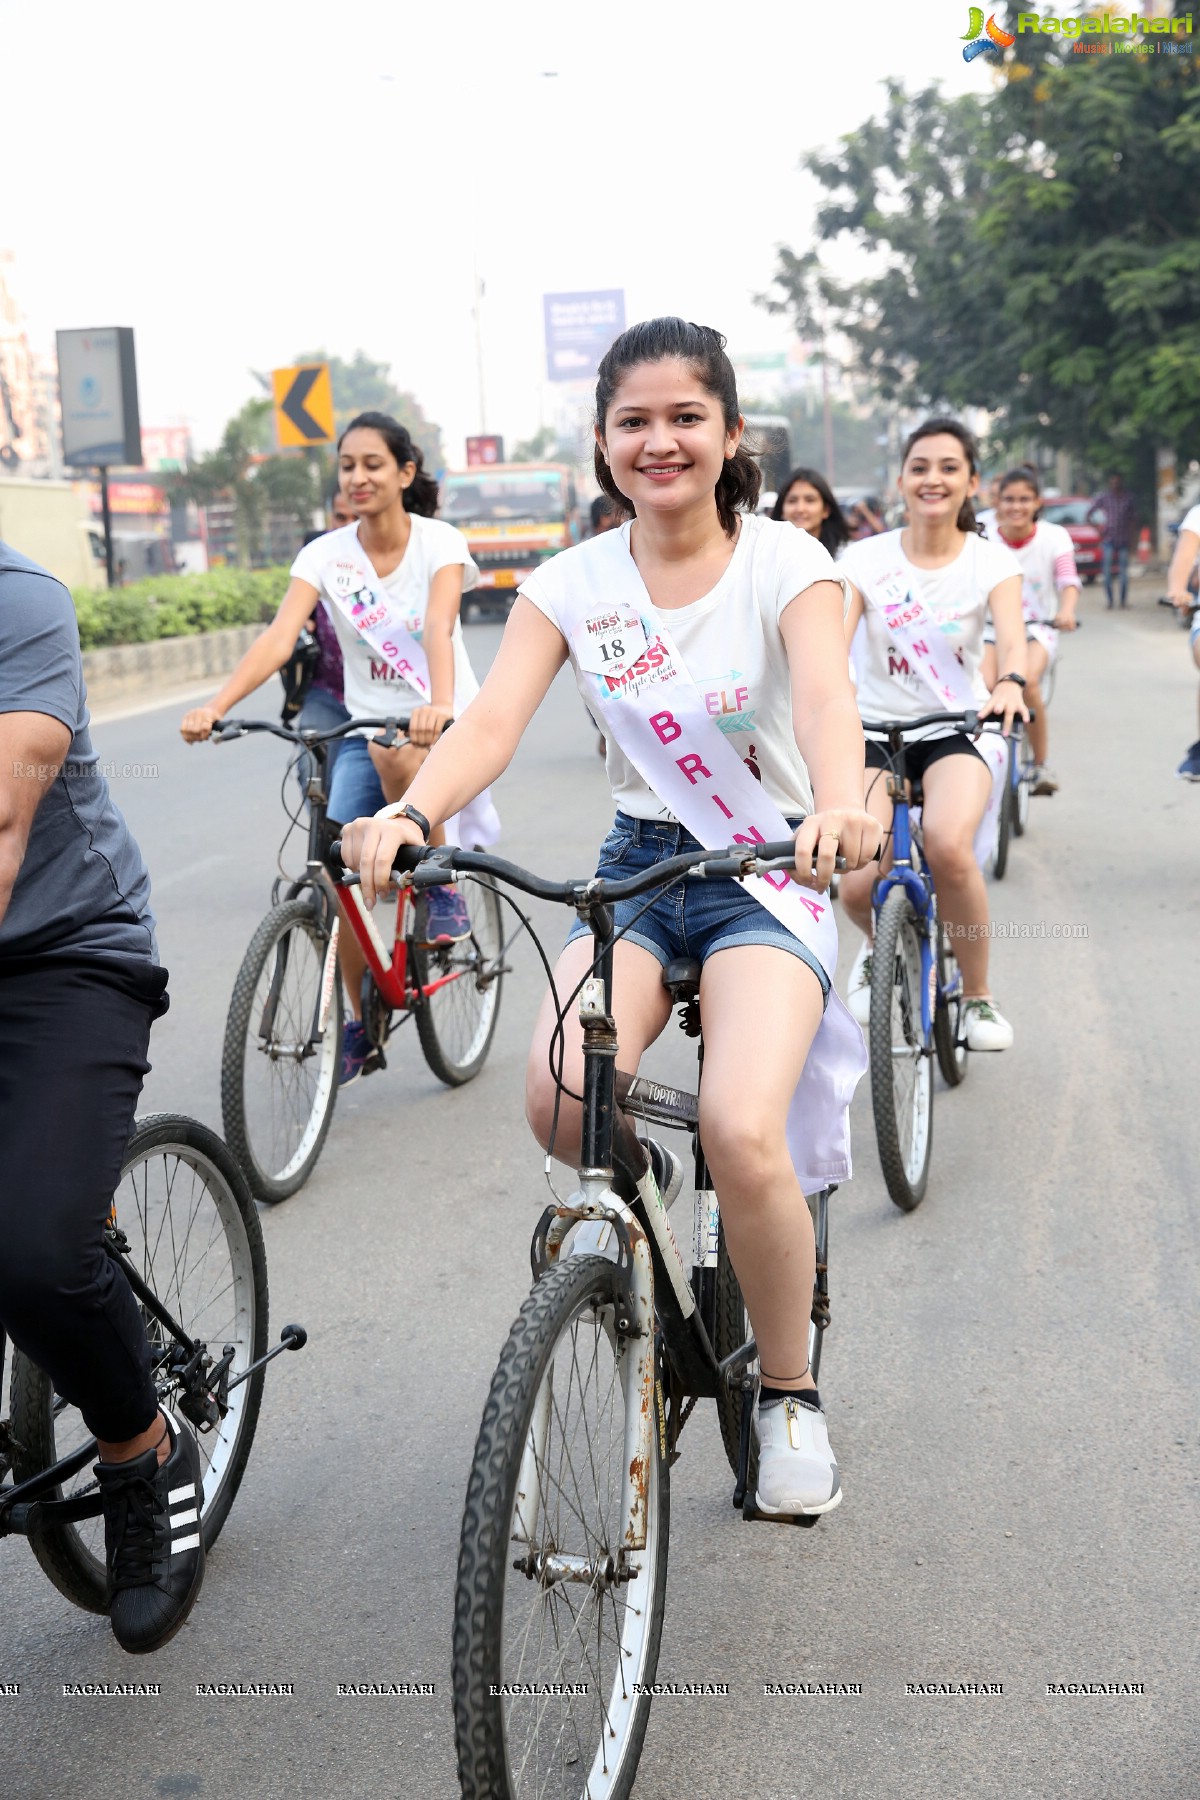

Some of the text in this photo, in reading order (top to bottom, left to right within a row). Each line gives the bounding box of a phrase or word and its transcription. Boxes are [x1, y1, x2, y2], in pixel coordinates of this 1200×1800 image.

[587, 616, 618, 634] MISS
[888, 606, 921, 631] MISS
[598, 639, 625, 662] 18
[660, 669, 678, 683] 2018
[704, 687, 749, 716] ELF
